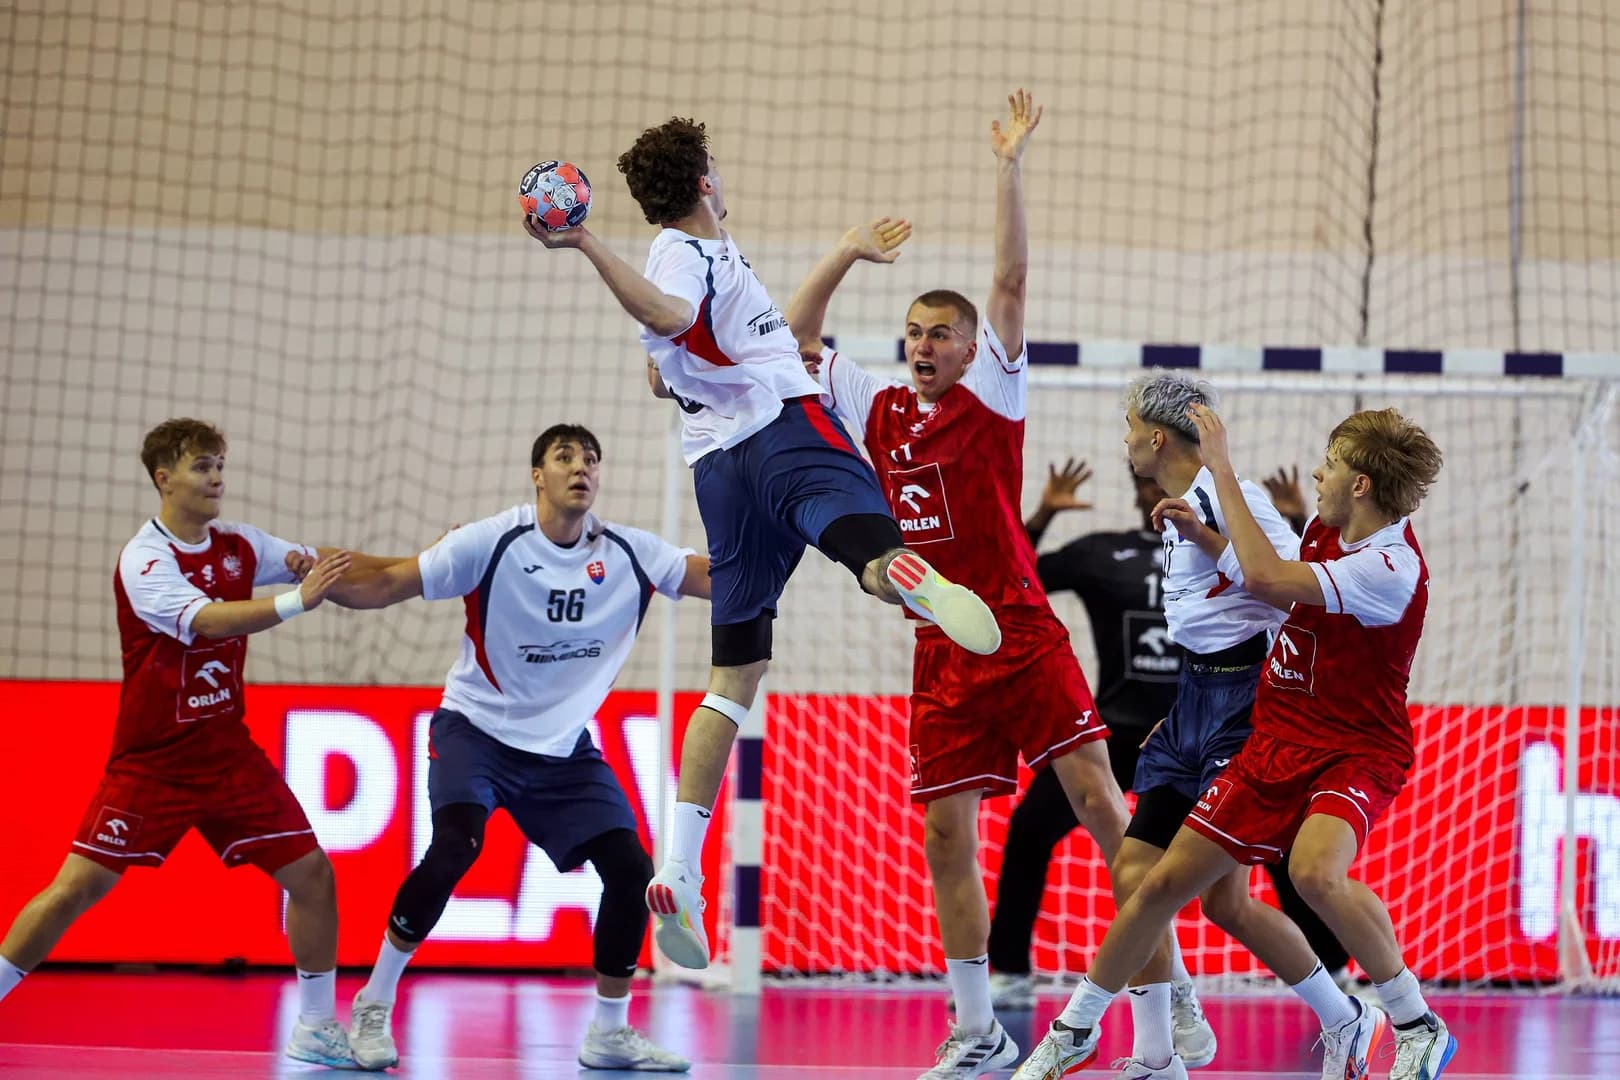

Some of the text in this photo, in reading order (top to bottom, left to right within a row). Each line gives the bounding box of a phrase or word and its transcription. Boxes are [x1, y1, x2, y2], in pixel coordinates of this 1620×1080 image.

[900, 515, 940, 532] ORLEN
[546, 588, 586, 623] 56
[1270, 656, 1305, 682] ORLEN
